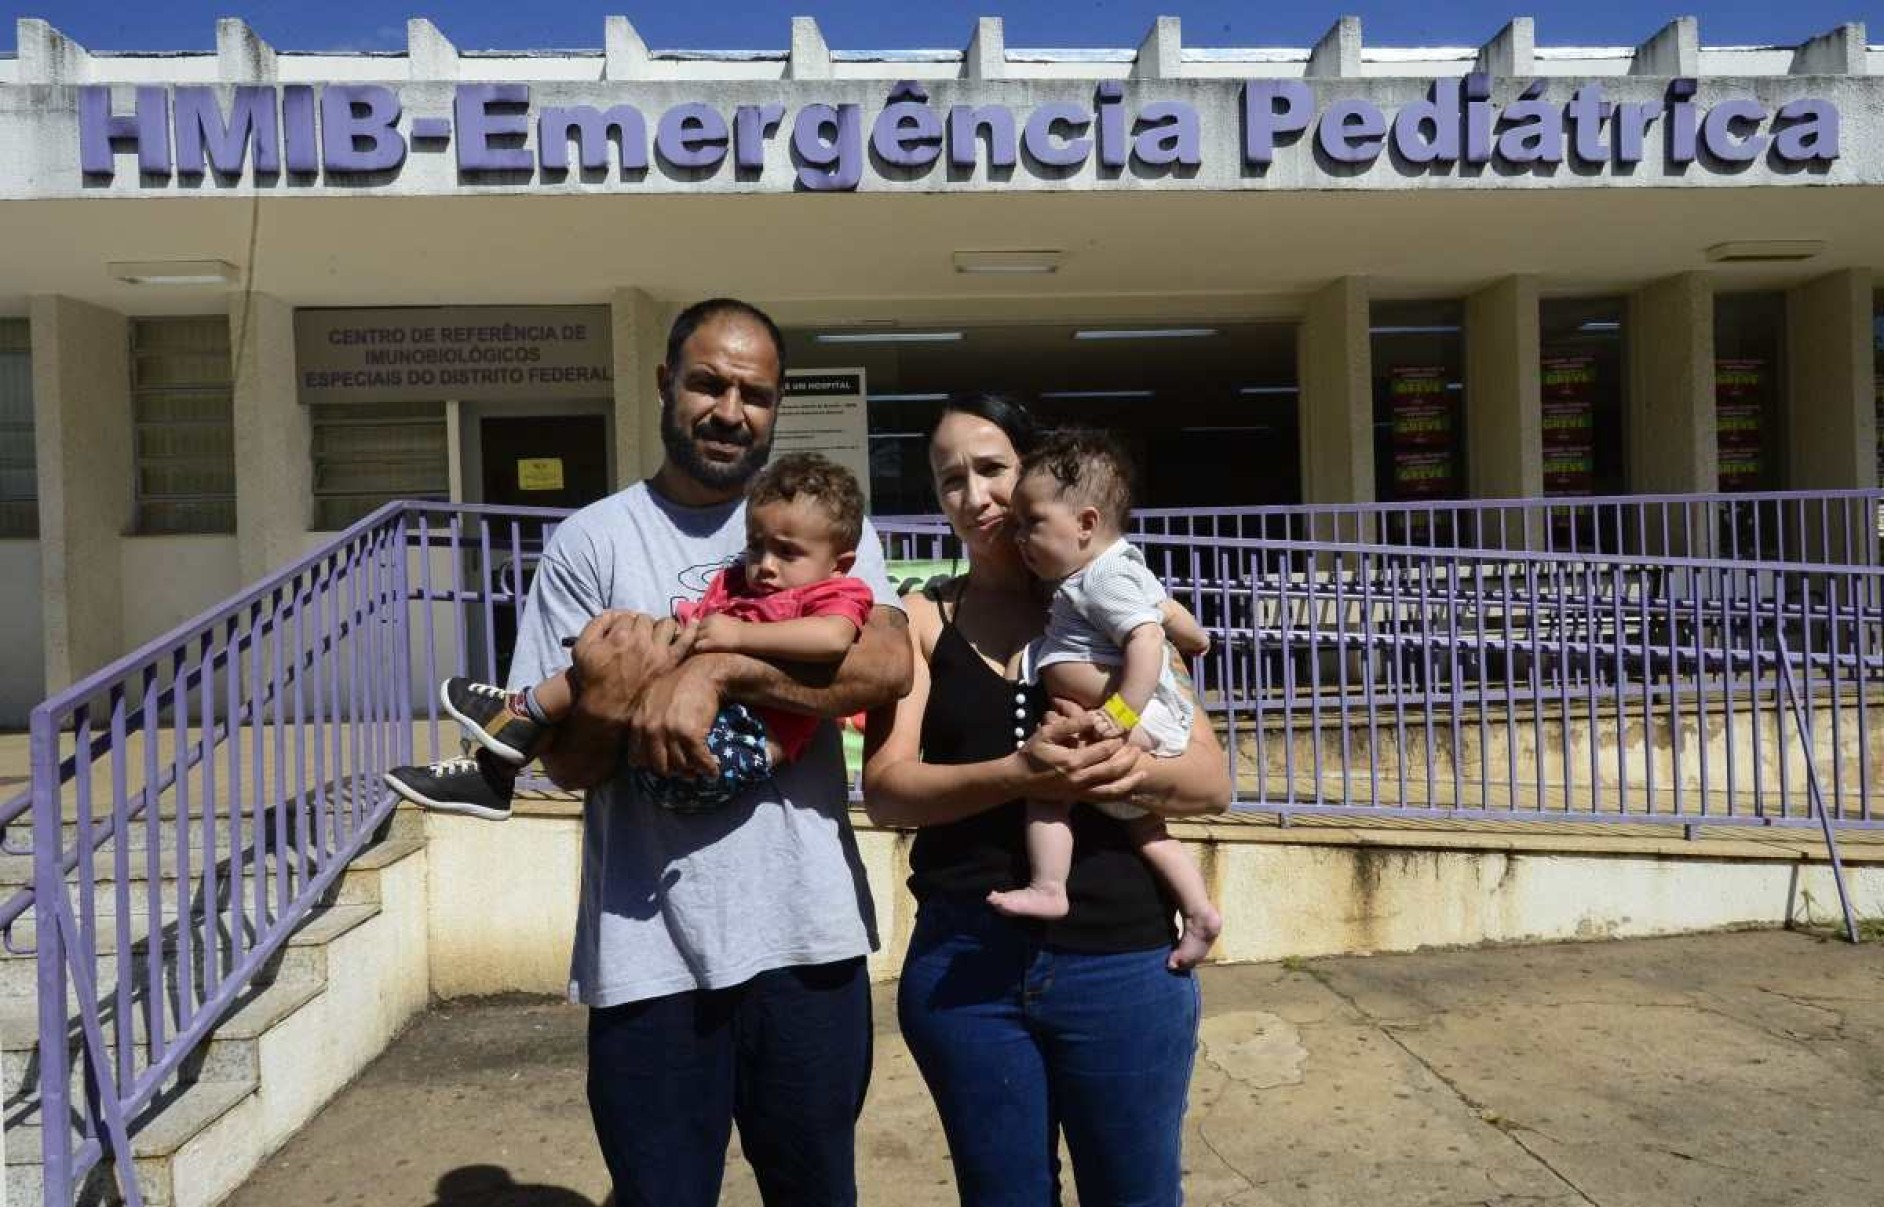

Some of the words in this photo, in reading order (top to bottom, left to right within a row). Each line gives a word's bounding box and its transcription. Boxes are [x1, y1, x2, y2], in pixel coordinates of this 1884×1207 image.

[79, 80, 1202, 191] HMIB-Emergência
[1242, 73, 1840, 166] Pediátrica
[328, 327, 405, 345] CENTRO
[411, 327, 437, 343] DE
[441, 322, 557, 342] REFERÊNCIA
[561, 324, 586, 340] DE
[365, 346, 541, 365] IMUNOBIOLÓGICOS
[305, 370, 404, 388] ESPECIAIS
[408, 369, 435, 385] DO
[440, 367, 524, 385] DISTRITO
[528, 366, 614, 383] FEDERAL
[808, 381, 850, 390] HOSPITAL
